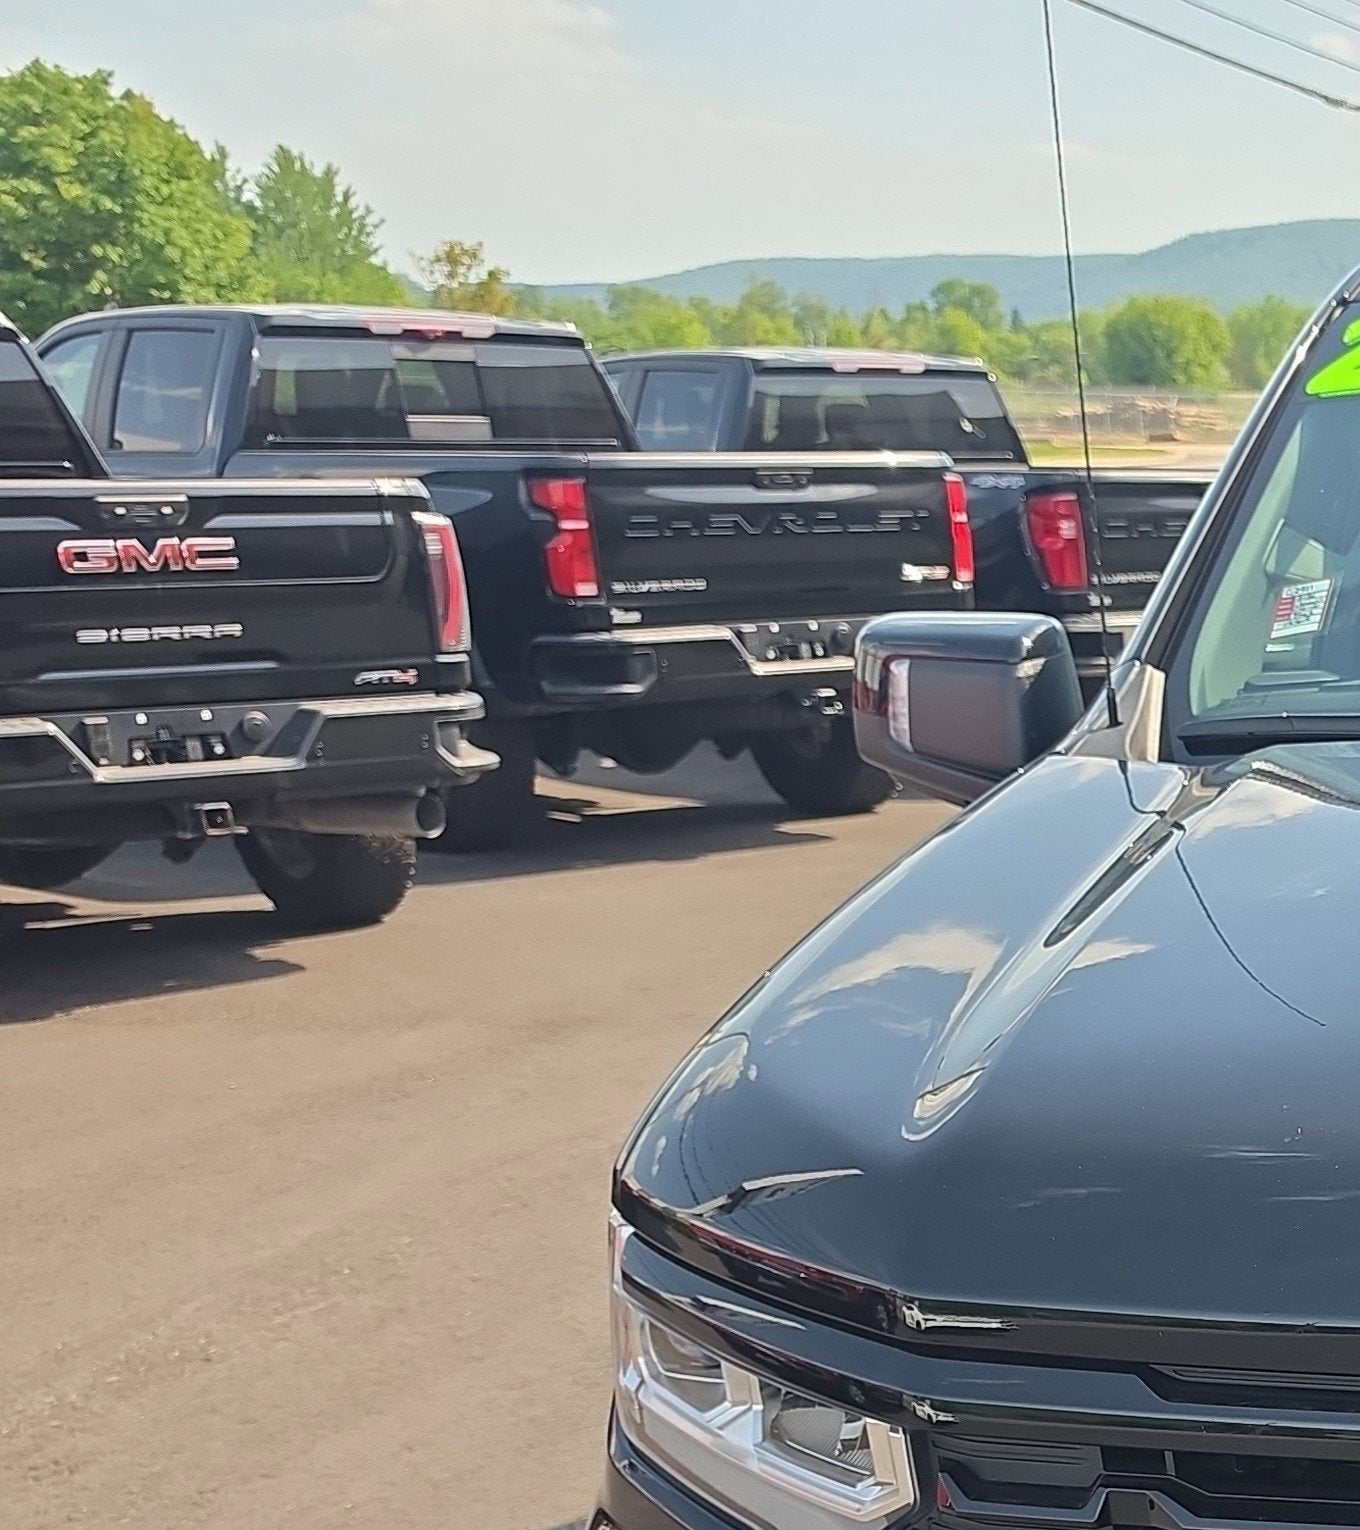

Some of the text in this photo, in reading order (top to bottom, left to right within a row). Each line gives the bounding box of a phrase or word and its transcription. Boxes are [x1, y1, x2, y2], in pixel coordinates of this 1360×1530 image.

[624, 509, 930, 538] CHEVROLET
[57, 534, 241, 574] GMC
[610, 578, 708, 595] SILVERADO
[75, 623, 244, 644] SIERRA
[354, 668, 419, 685] AT4
